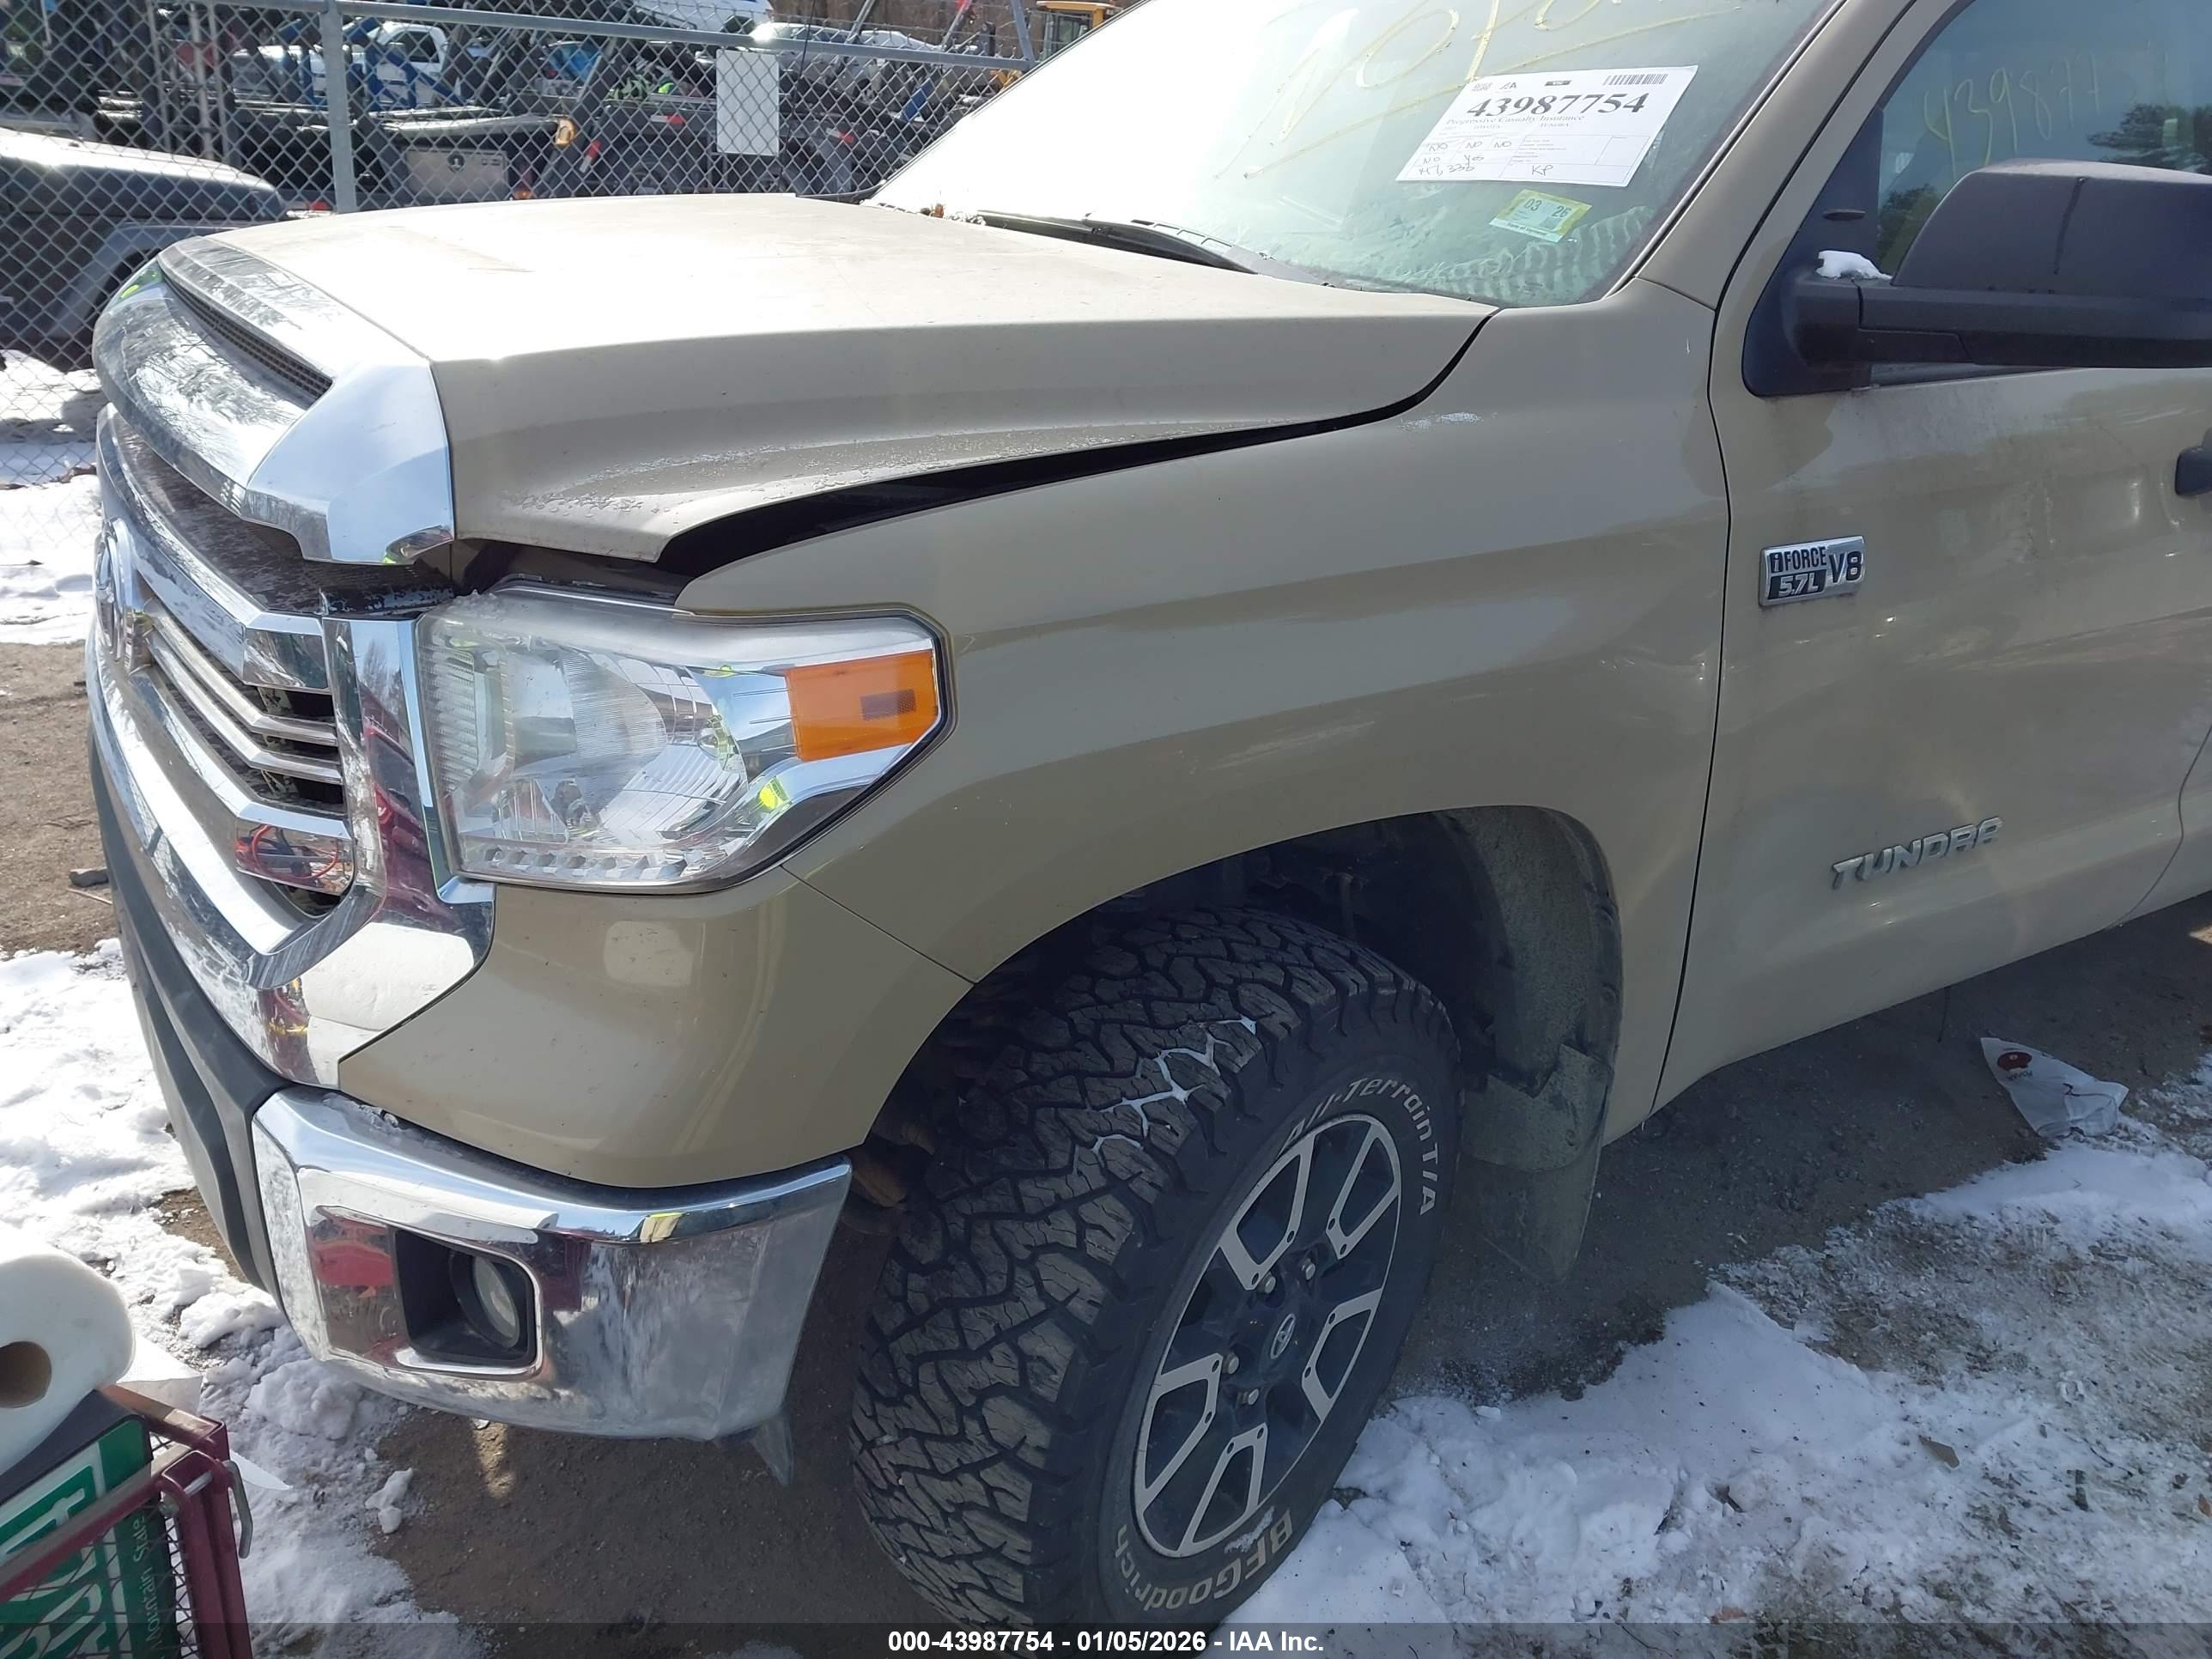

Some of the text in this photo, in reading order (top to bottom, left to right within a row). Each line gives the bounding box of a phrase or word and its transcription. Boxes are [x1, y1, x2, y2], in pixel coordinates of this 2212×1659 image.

[1467, 92, 1650, 117] 43987754
[1494, 140, 1512, 149] NO
[1525, 198, 1542, 211] 03
[1828, 550, 1863, 584] V8
[1779, 571, 1820, 598] 5.7L
[1832, 816, 2004, 890] TUNDRA
[1275, 1077, 1433, 1158] All-Terrain
[1115, 1509, 1294, 1612] BFGoodrich
